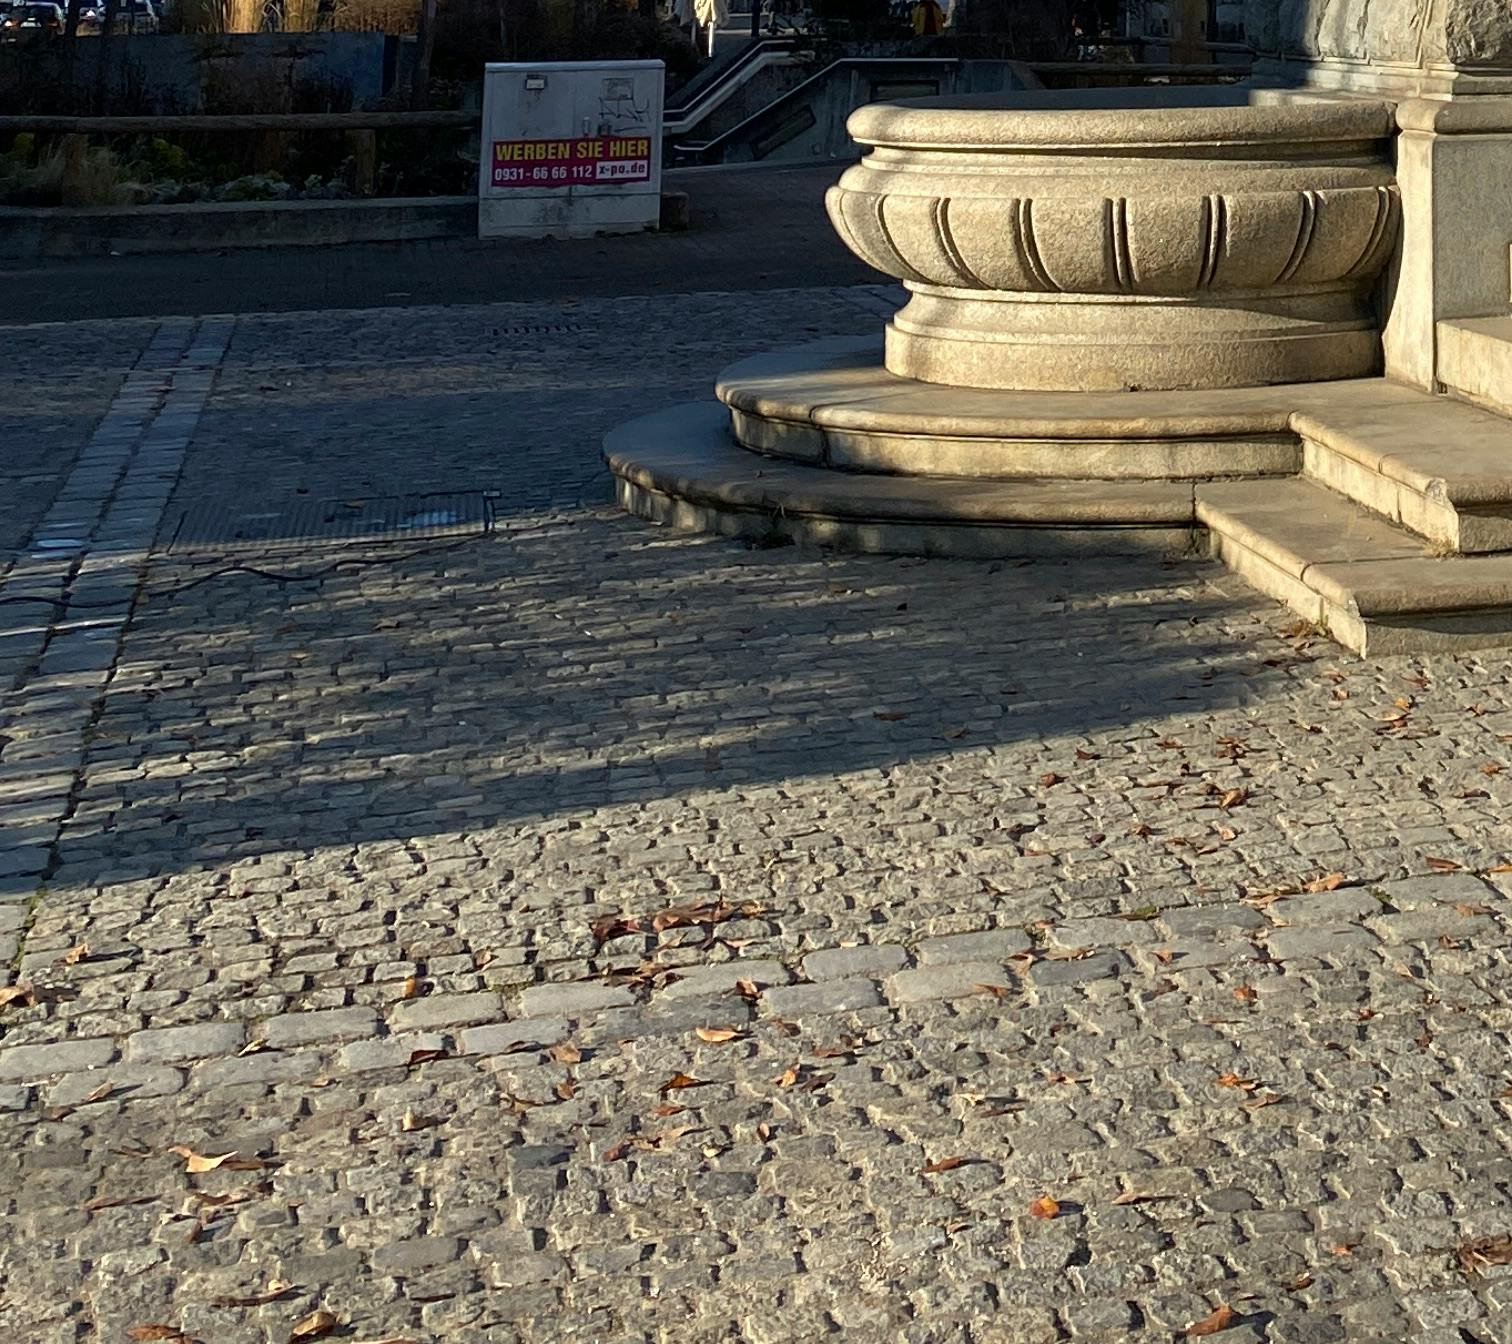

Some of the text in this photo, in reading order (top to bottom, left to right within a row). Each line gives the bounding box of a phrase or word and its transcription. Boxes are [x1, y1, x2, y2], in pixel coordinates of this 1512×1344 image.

[496, 139, 648, 161] WERBEN SIE HIER
[551, 166, 567, 179] 66
[572, 165, 593, 178] 112
[599, 162, 646, 177] x-po.de
